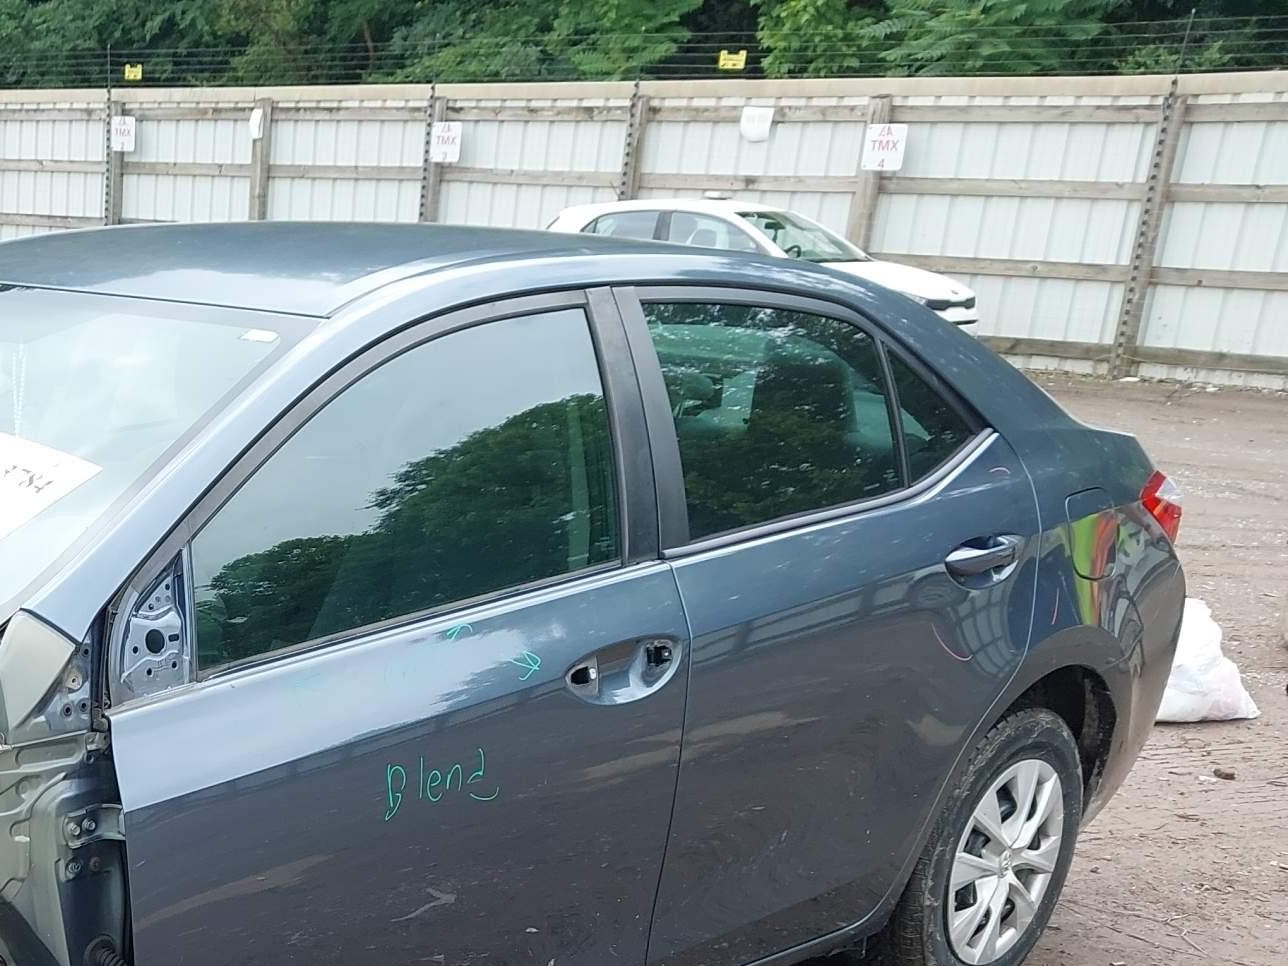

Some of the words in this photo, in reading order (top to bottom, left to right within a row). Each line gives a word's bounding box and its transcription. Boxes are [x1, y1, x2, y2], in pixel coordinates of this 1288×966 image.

[436, 135, 457, 145] TMX
[871, 139, 899, 152] TMX
[384, 748, 500, 822] Blend
